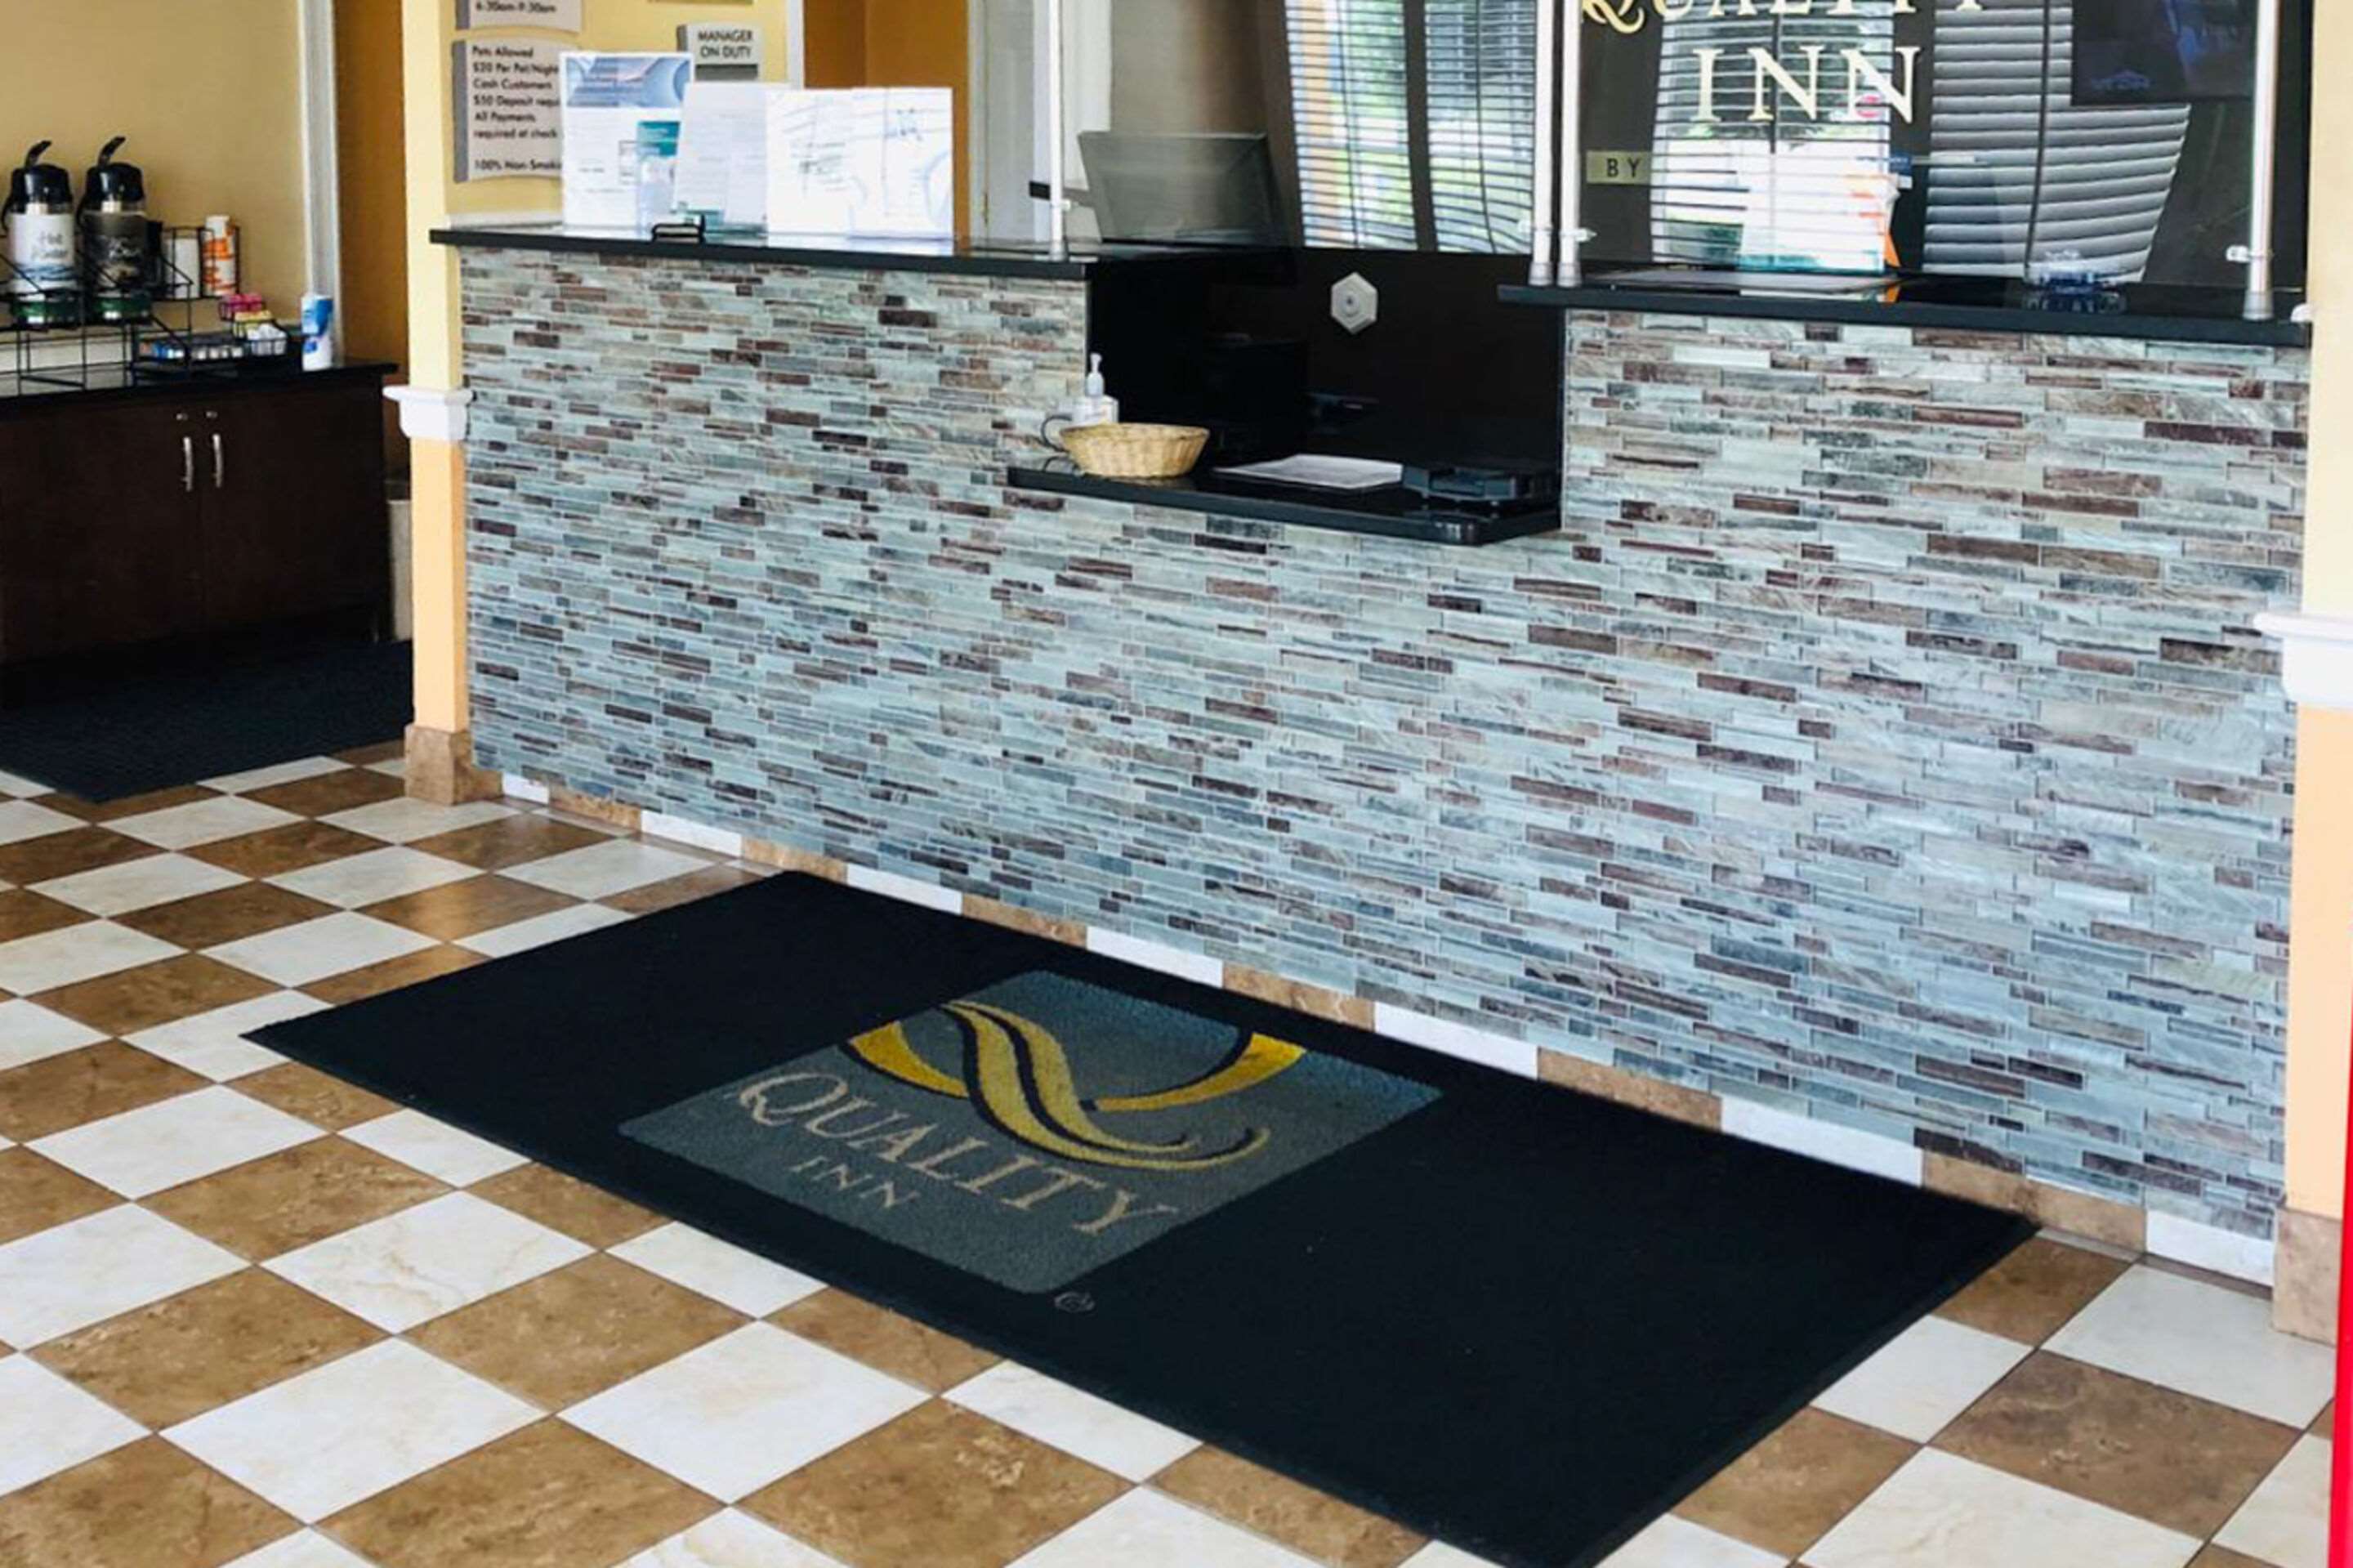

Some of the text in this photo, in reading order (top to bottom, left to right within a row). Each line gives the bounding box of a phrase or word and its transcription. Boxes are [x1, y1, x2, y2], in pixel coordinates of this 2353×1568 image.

[699, 30, 752, 42] MANAGER
[472, 46, 534, 58] Pets Allowed
[700, 46, 752, 59] ON DUTY
[496, 63, 511, 74] Per
[473, 78, 498, 89] Cash
[1690, 46, 1921, 123] INN
[496, 95, 533, 107] Deposit
[473, 129, 516, 140] required
[1606, 157, 1641, 178] BY
[725, 1072, 1179, 1234] QUALITY
[789, 1155, 922, 1209] INN
